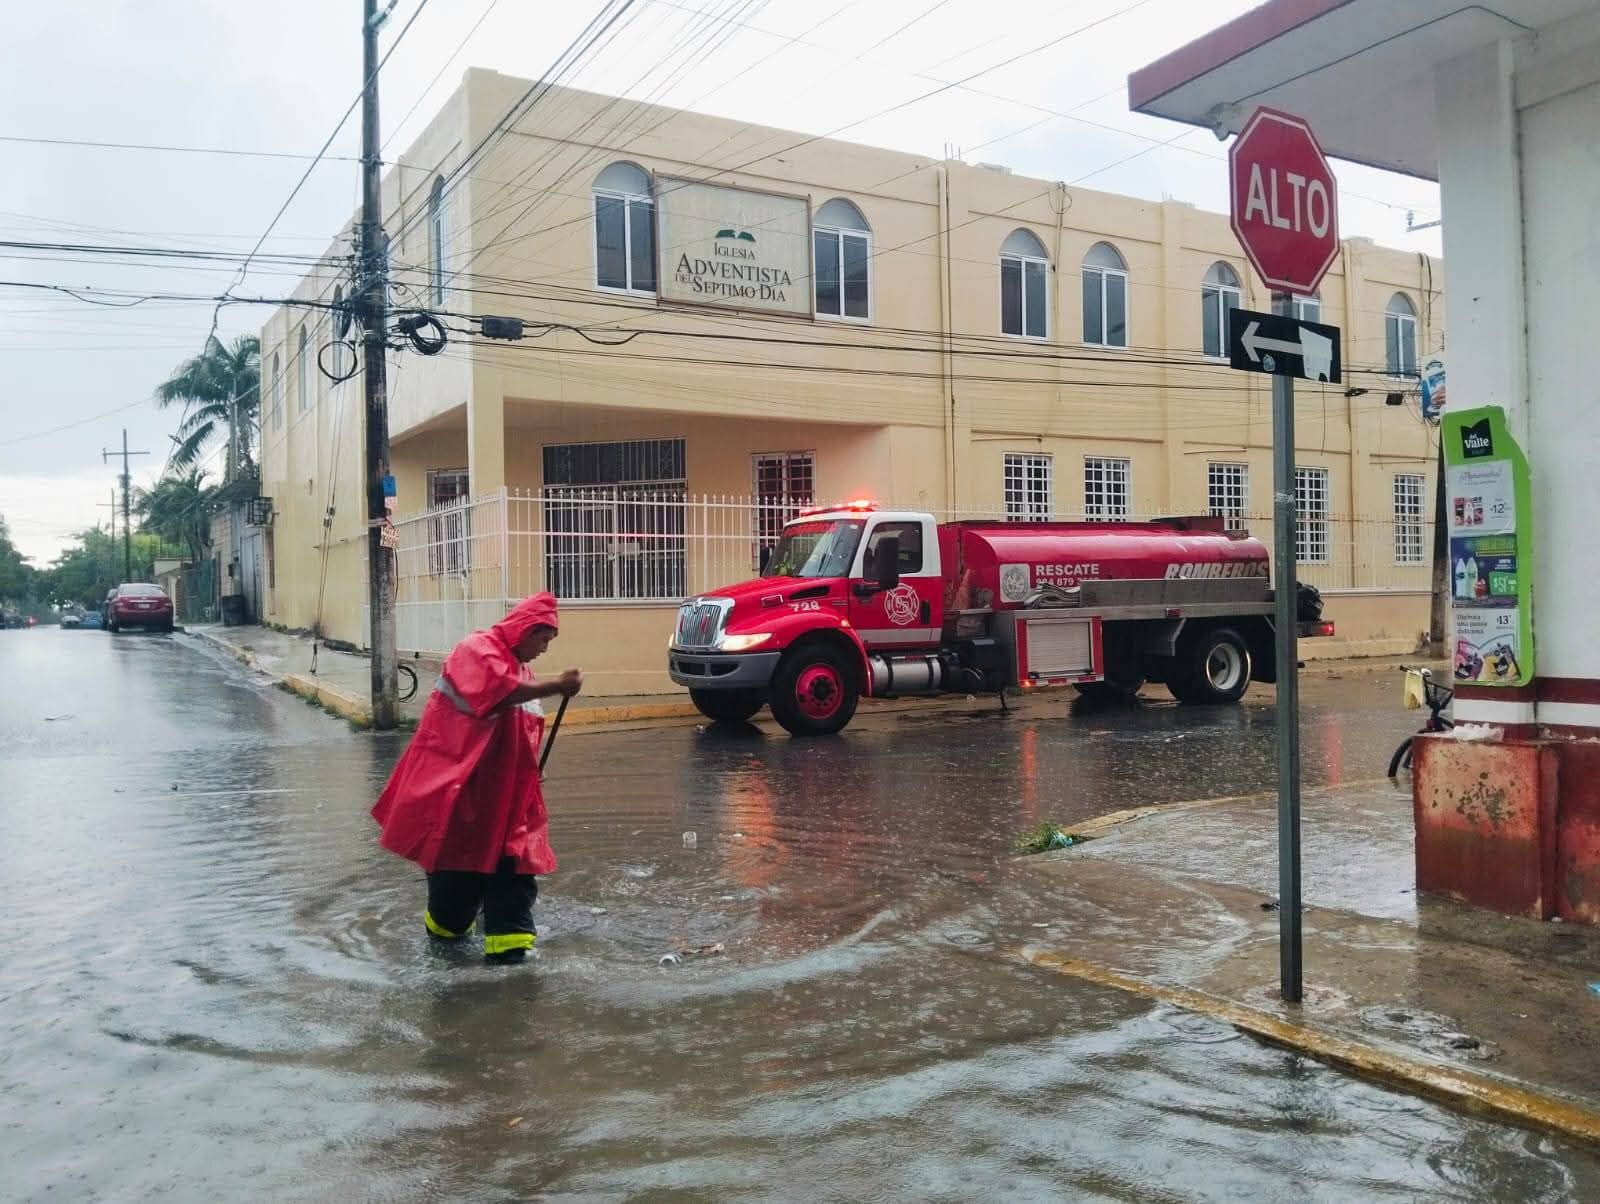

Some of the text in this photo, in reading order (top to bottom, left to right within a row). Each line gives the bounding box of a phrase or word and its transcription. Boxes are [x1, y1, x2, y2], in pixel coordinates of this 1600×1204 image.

[1244, 162, 1330, 239] ALTO
[714, 242, 756, 261] IGLESIA
[677, 252, 792, 286] ADVENTISTA
[692, 276, 756, 299] SEPTIMO
[1464, 438, 1489, 449] Valle
[1035, 563, 1100, 576] RESCATE
[1164, 562, 1269, 580] BOMBEROS
[1057, 577, 1074, 586] 879
